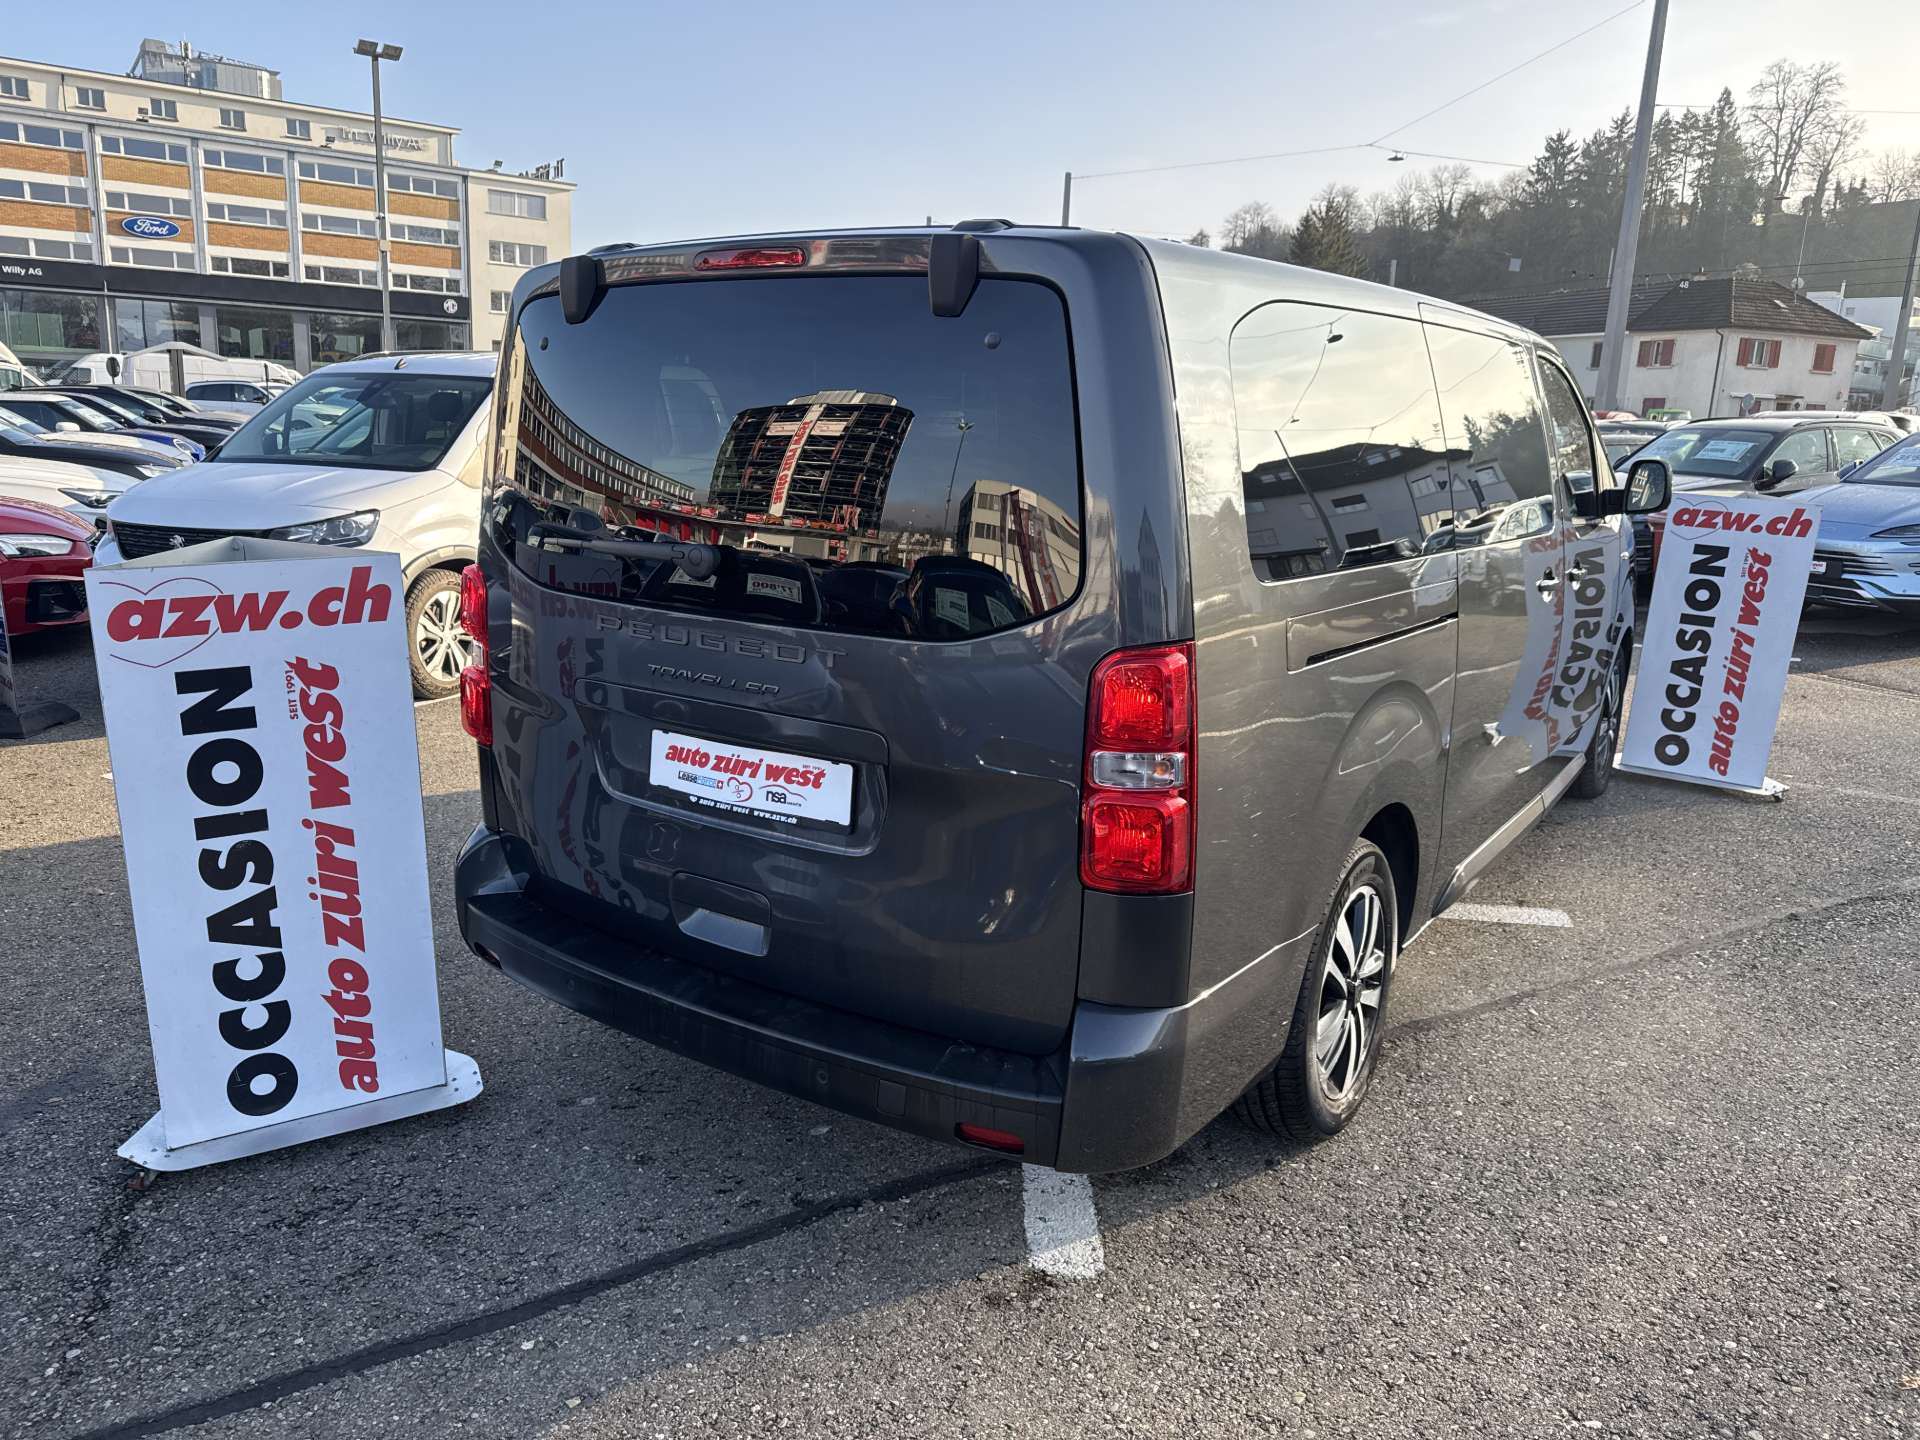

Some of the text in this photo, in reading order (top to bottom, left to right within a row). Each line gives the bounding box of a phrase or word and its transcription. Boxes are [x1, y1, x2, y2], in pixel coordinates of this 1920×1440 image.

[134, 219, 169, 235] Ford
[2, 265, 43, 276] Willy AG
[1672, 507, 1813, 538] azw.ch
[106, 566, 392, 643] azw.ch
[596, 614, 849, 668] PEUGEOT
[1654, 543, 1730, 766] OCCASION
[1709, 547, 1773, 777] auto züri west
[285, 670, 299, 720] SEIT 1991
[647, 664, 780, 697] TRAVELLER
[665, 744, 827, 789] auto züri west
[766, 791, 787, 805] nsa
[174, 666, 298, 1117] OCCASION
[284, 656, 380, 1093] auto züri west
